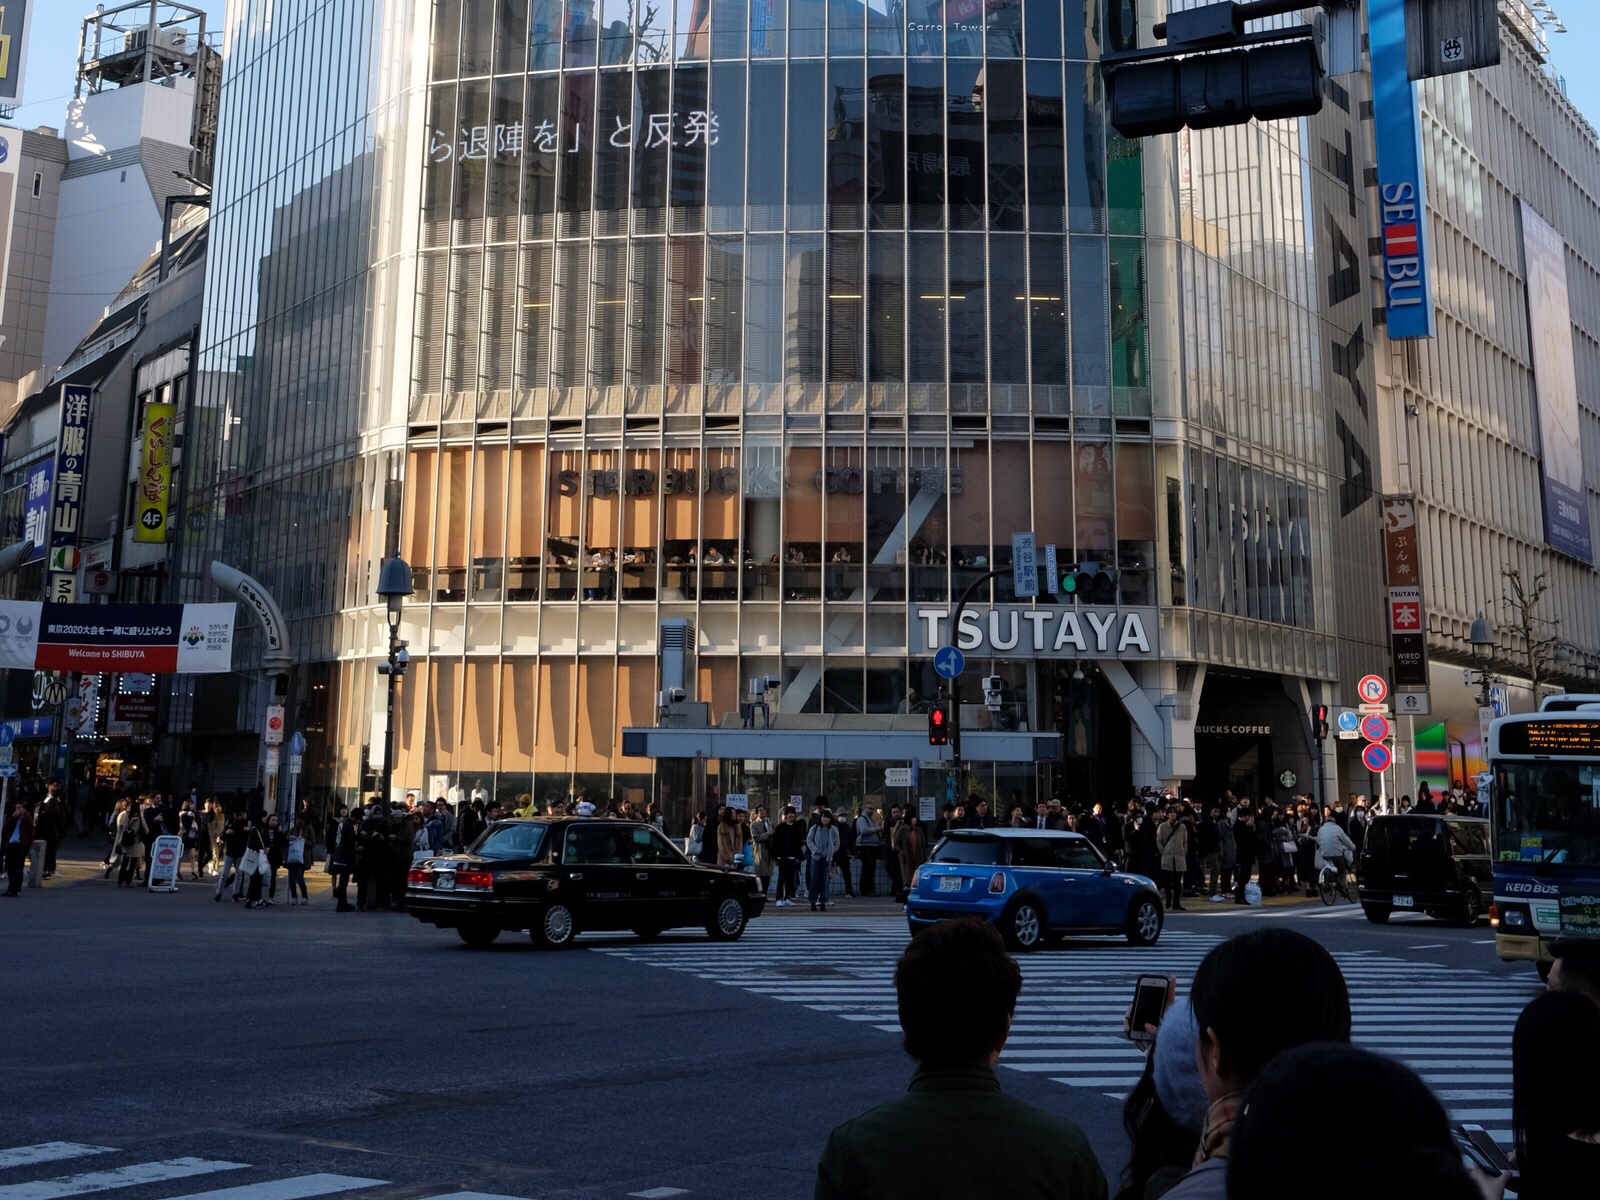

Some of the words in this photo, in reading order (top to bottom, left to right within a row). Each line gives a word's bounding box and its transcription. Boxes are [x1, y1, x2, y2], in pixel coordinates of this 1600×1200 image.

[907, 21, 947, 32] Carro
[1382, 181, 1423, 311] SEIBU
[54, 394, 88, 533] 洋服の青山
[29, 470, 50, 501] 洋服の
[557, 466, 790, 497] STARBUCKS
[25, 505, 47, 548] 青山
[142, 511, 161, 526] 4F
[1022, 537, 1035, 591] 渋谷駅前
[1396, 605, 1416, 627] 本
[48, 623, 173, 637] 東京2020大会を一緒に盛り上げよう
[918, 609, 1151, 653] TSUTAYA
[68, 649, 101, 659] Welcome
[102, 650, 110, 659] to
[111, 650, 146, 659] SHIBUYA
[1397, 652, 1421, 660] WIRED
[1231, 725, 1271, 735] COFFEE
[1505, 882, 1532, 893] KEIO
[1533, 883, 1560, 894] BUS
